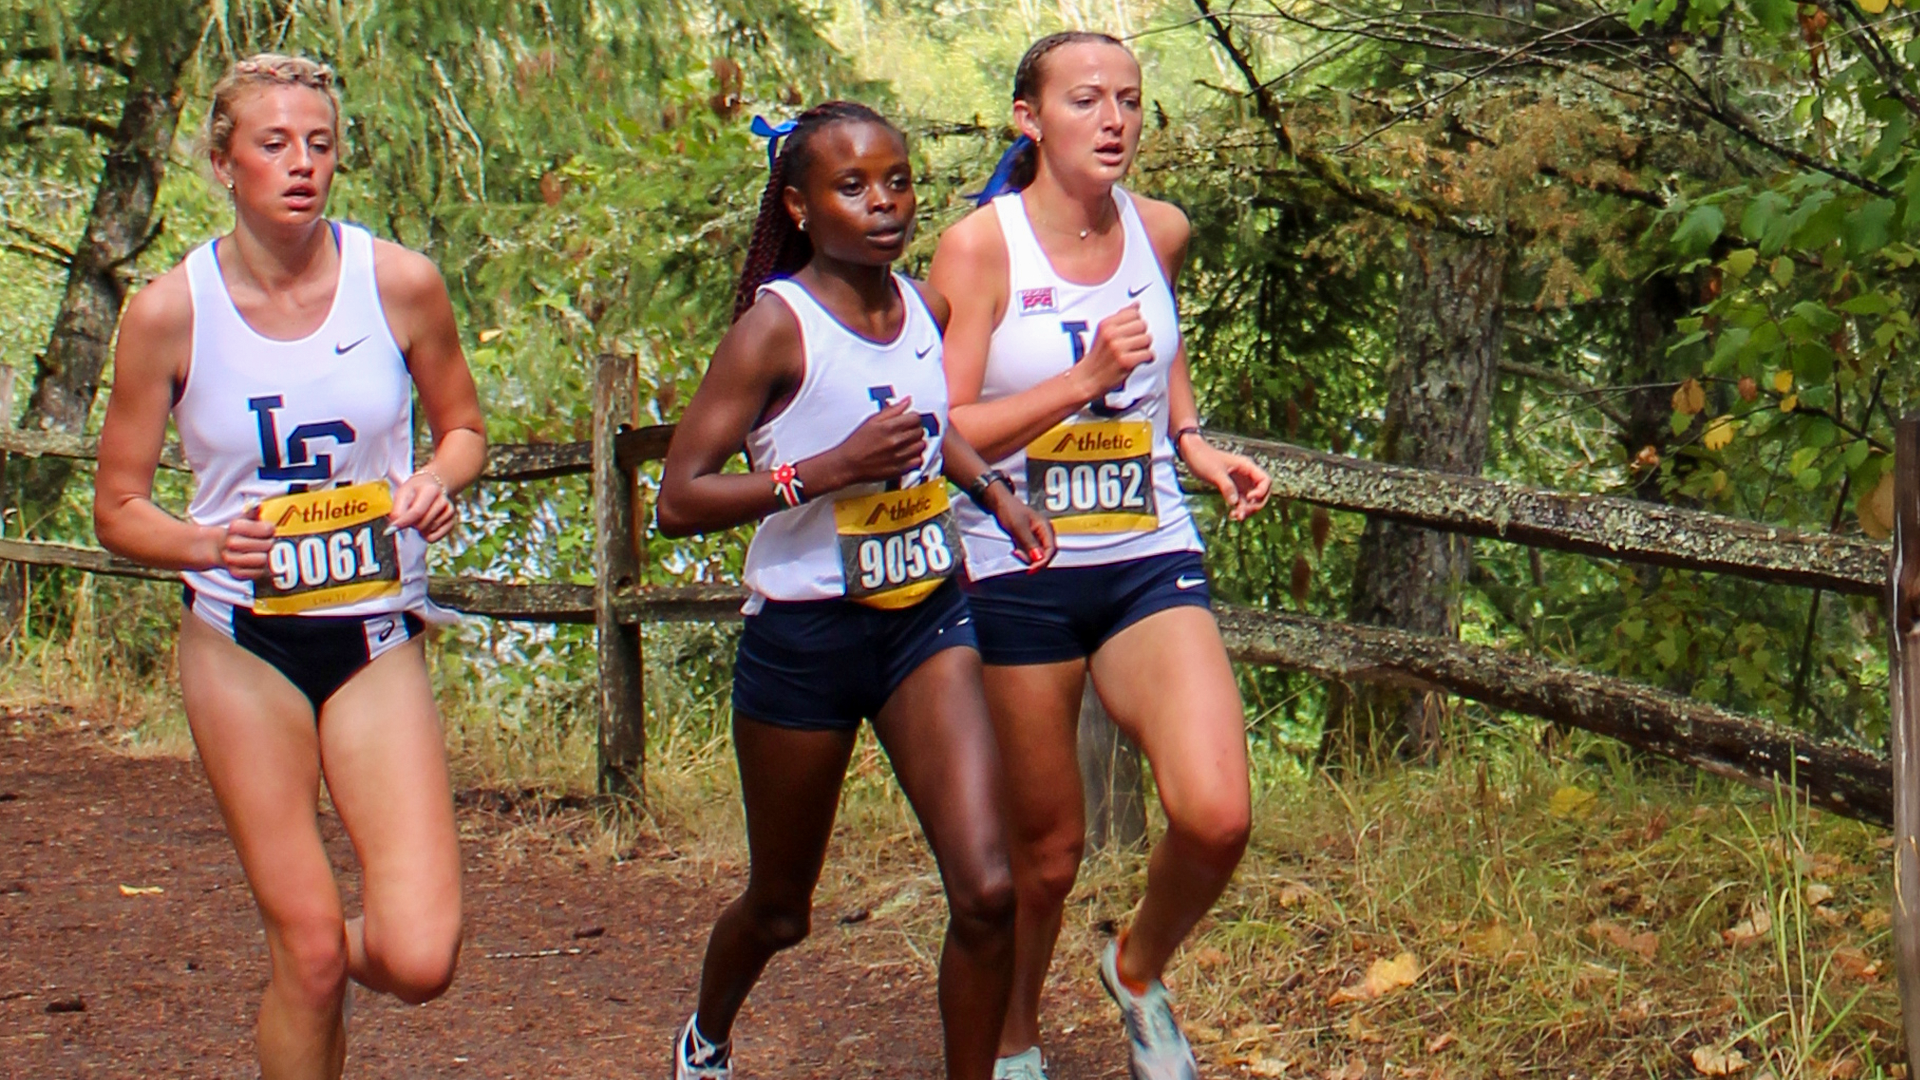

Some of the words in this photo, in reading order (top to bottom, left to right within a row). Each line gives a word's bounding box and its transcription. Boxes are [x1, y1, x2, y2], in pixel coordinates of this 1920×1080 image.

[1045, 462, 1144, 511] 9062
[269, 527, 380, 590] 9061
[860, 523, 952, 589] 9058
